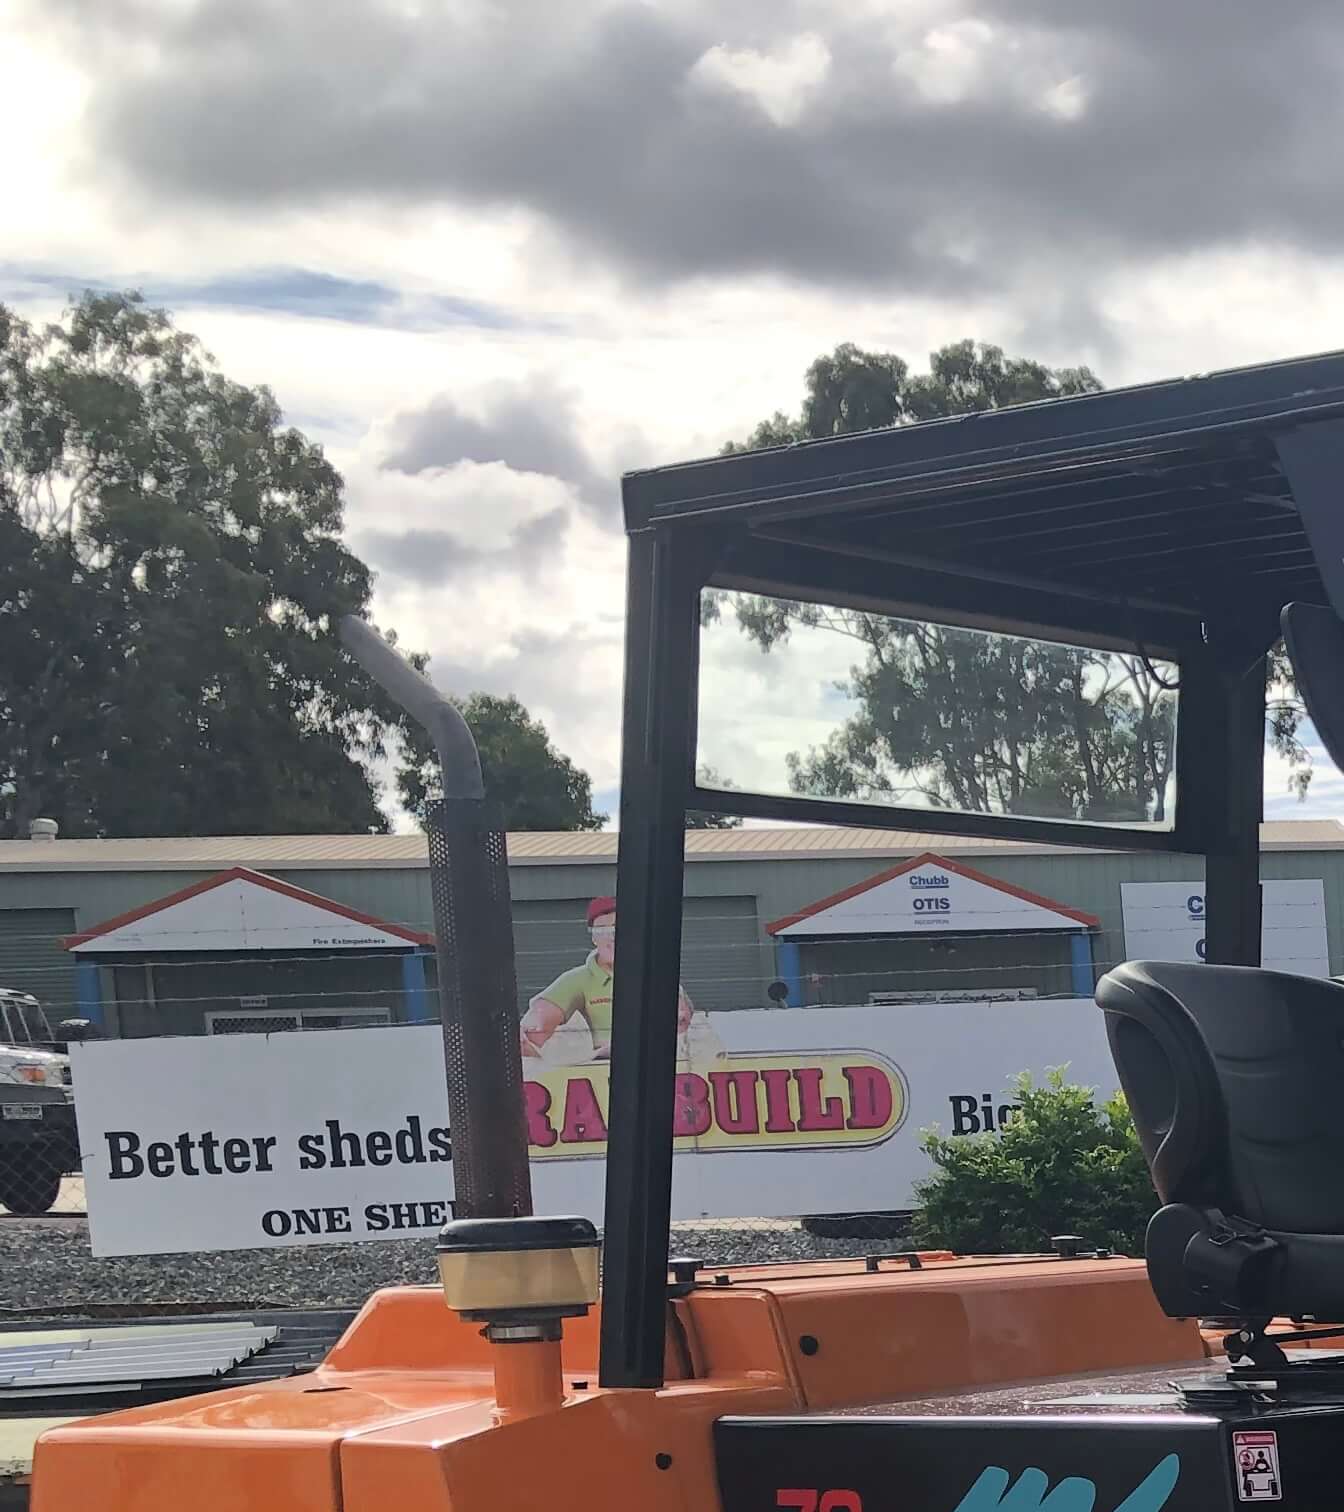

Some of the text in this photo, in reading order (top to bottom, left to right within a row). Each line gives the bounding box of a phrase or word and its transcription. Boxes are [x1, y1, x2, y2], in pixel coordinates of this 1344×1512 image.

[910, 875, 949, 886] Chubb
[913, 898, 950, 910] OTIS
[522, 1066, 893, 1147] RABUILD
[105, 1115, 453, 1180] Better sheds
[262, 1206, 352, 1237] ONE
